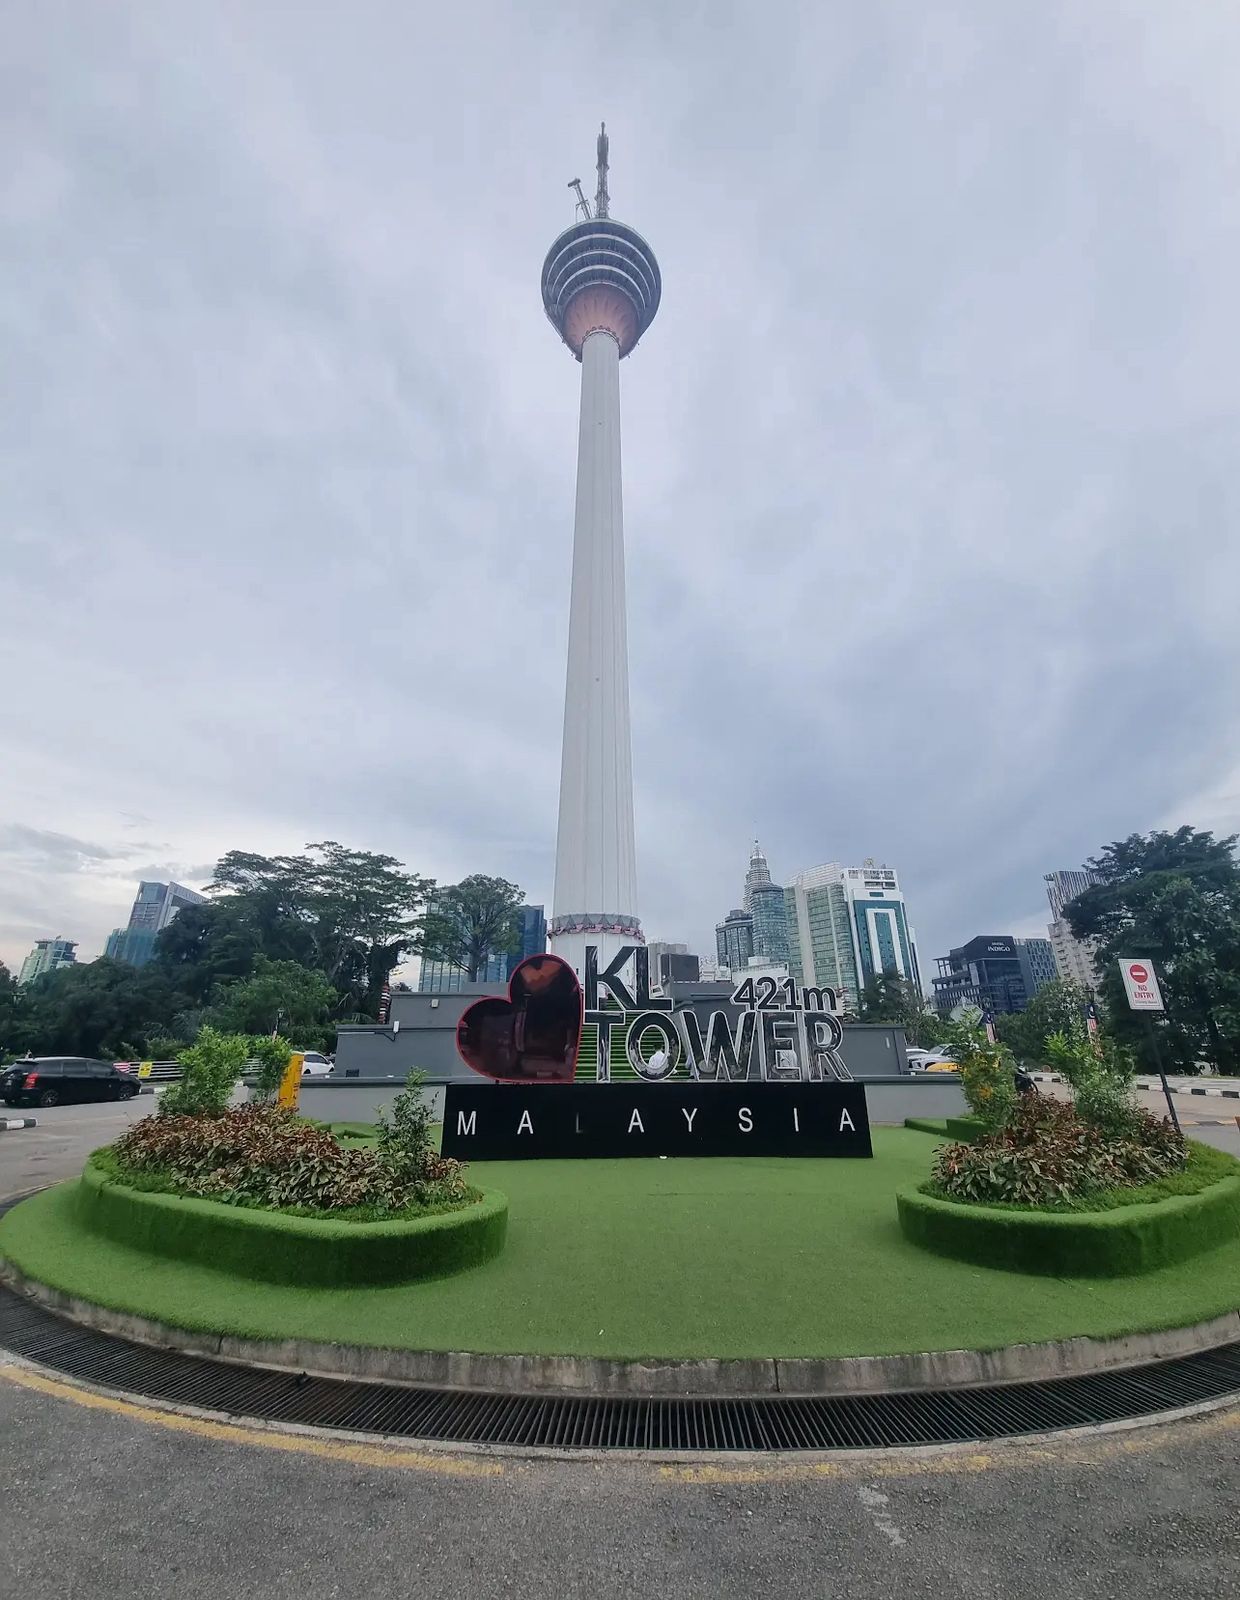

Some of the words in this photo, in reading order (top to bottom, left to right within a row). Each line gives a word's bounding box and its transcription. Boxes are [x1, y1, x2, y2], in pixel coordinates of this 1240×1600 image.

[584, 945, 674, 1011] KL
[730, 976, 838, 1011] 421m
[1137, 984, 1148, 992] NO
[1134, 991, 1155, 999] ENTRY
[583, 1010, 854, 1083] TOWER
[457, 1107, 856, 1136] MALAYSIA
